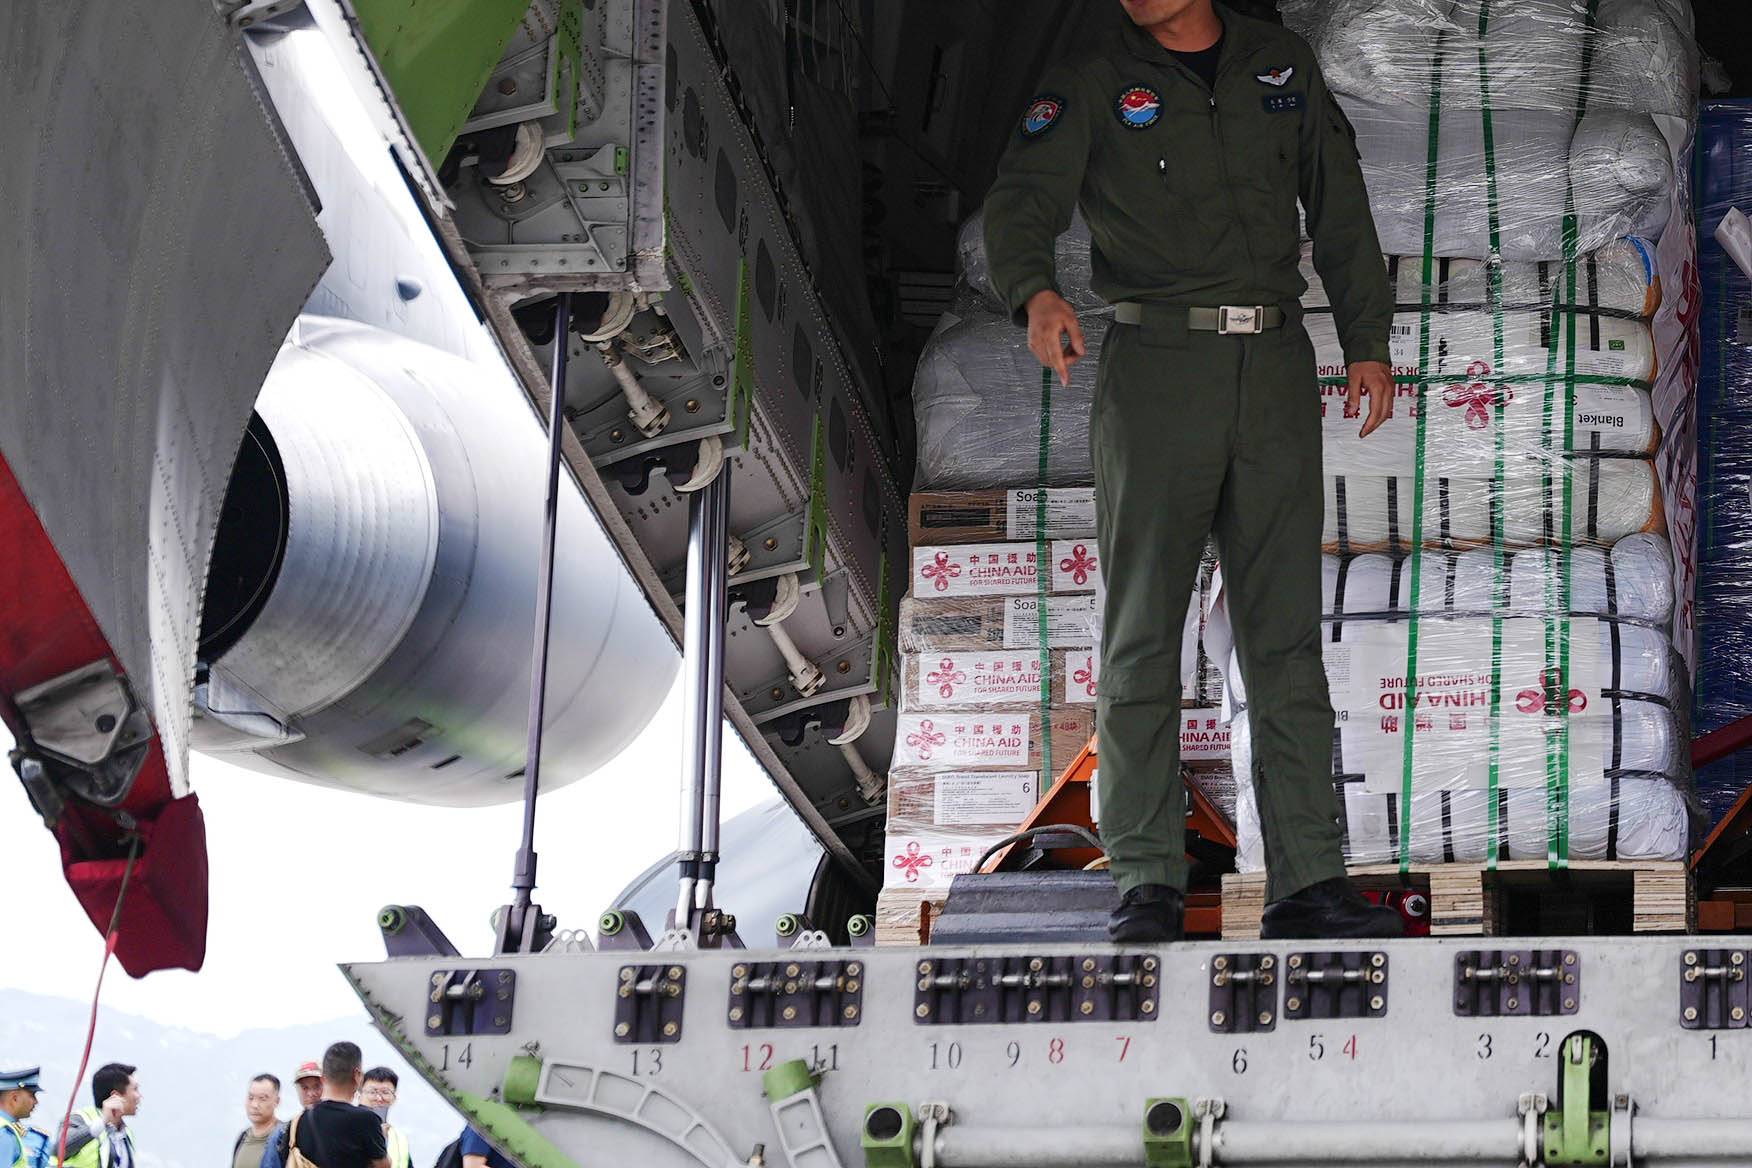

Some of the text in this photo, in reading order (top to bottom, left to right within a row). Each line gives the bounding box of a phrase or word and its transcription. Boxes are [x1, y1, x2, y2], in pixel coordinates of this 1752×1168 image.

[1578, 414, 1624, 427] Blanket
[969, 551, 1037, 565] 中国援助
[969, 565, 1037, 578] CHINA AID
[1011, 577, 1037, 585] FUTURE
[1013, 599, 1038, 610] Soa
[974, 661, 1041, 672] 中国援助
[974, 673, 1041, 685] CHINA AID
[1380, 692, 1422, 710] AID
[954, 724, 1022, 736] 中国援助
[954, 737, 1022, 748] CHINA AID
[1179, 732, 1210, 743] HINA
[995, 748, 1020, 756] FUTURE
[1210, 743, 1231, 751] FUTUR
[1022, 782, 1030, 793] 6
[440, 1043, 473, 1072] 14
[631, 1046, 664, 1077] 13
[742, 1043, 774, 1073] 12
[809, 1043, 841, 1072] 11
[928, 1040, 963, 1070] 10
[1006, 1040, 1022, 1069] 9
[1047, 1037, 1065, 1064] 8
[1115, 1036, 1132, 1063] 7
[1232, 1047, 1248, 1075] 6
[1309, 1034, 1325, 1061] 5
[1342, 1034, 1358, 1061] 4
[1477, 1033, 1493, 1060] 3
[1535, 1032, 1551, 1059] 2
[1710, 1034, 1718, 1060] 1
